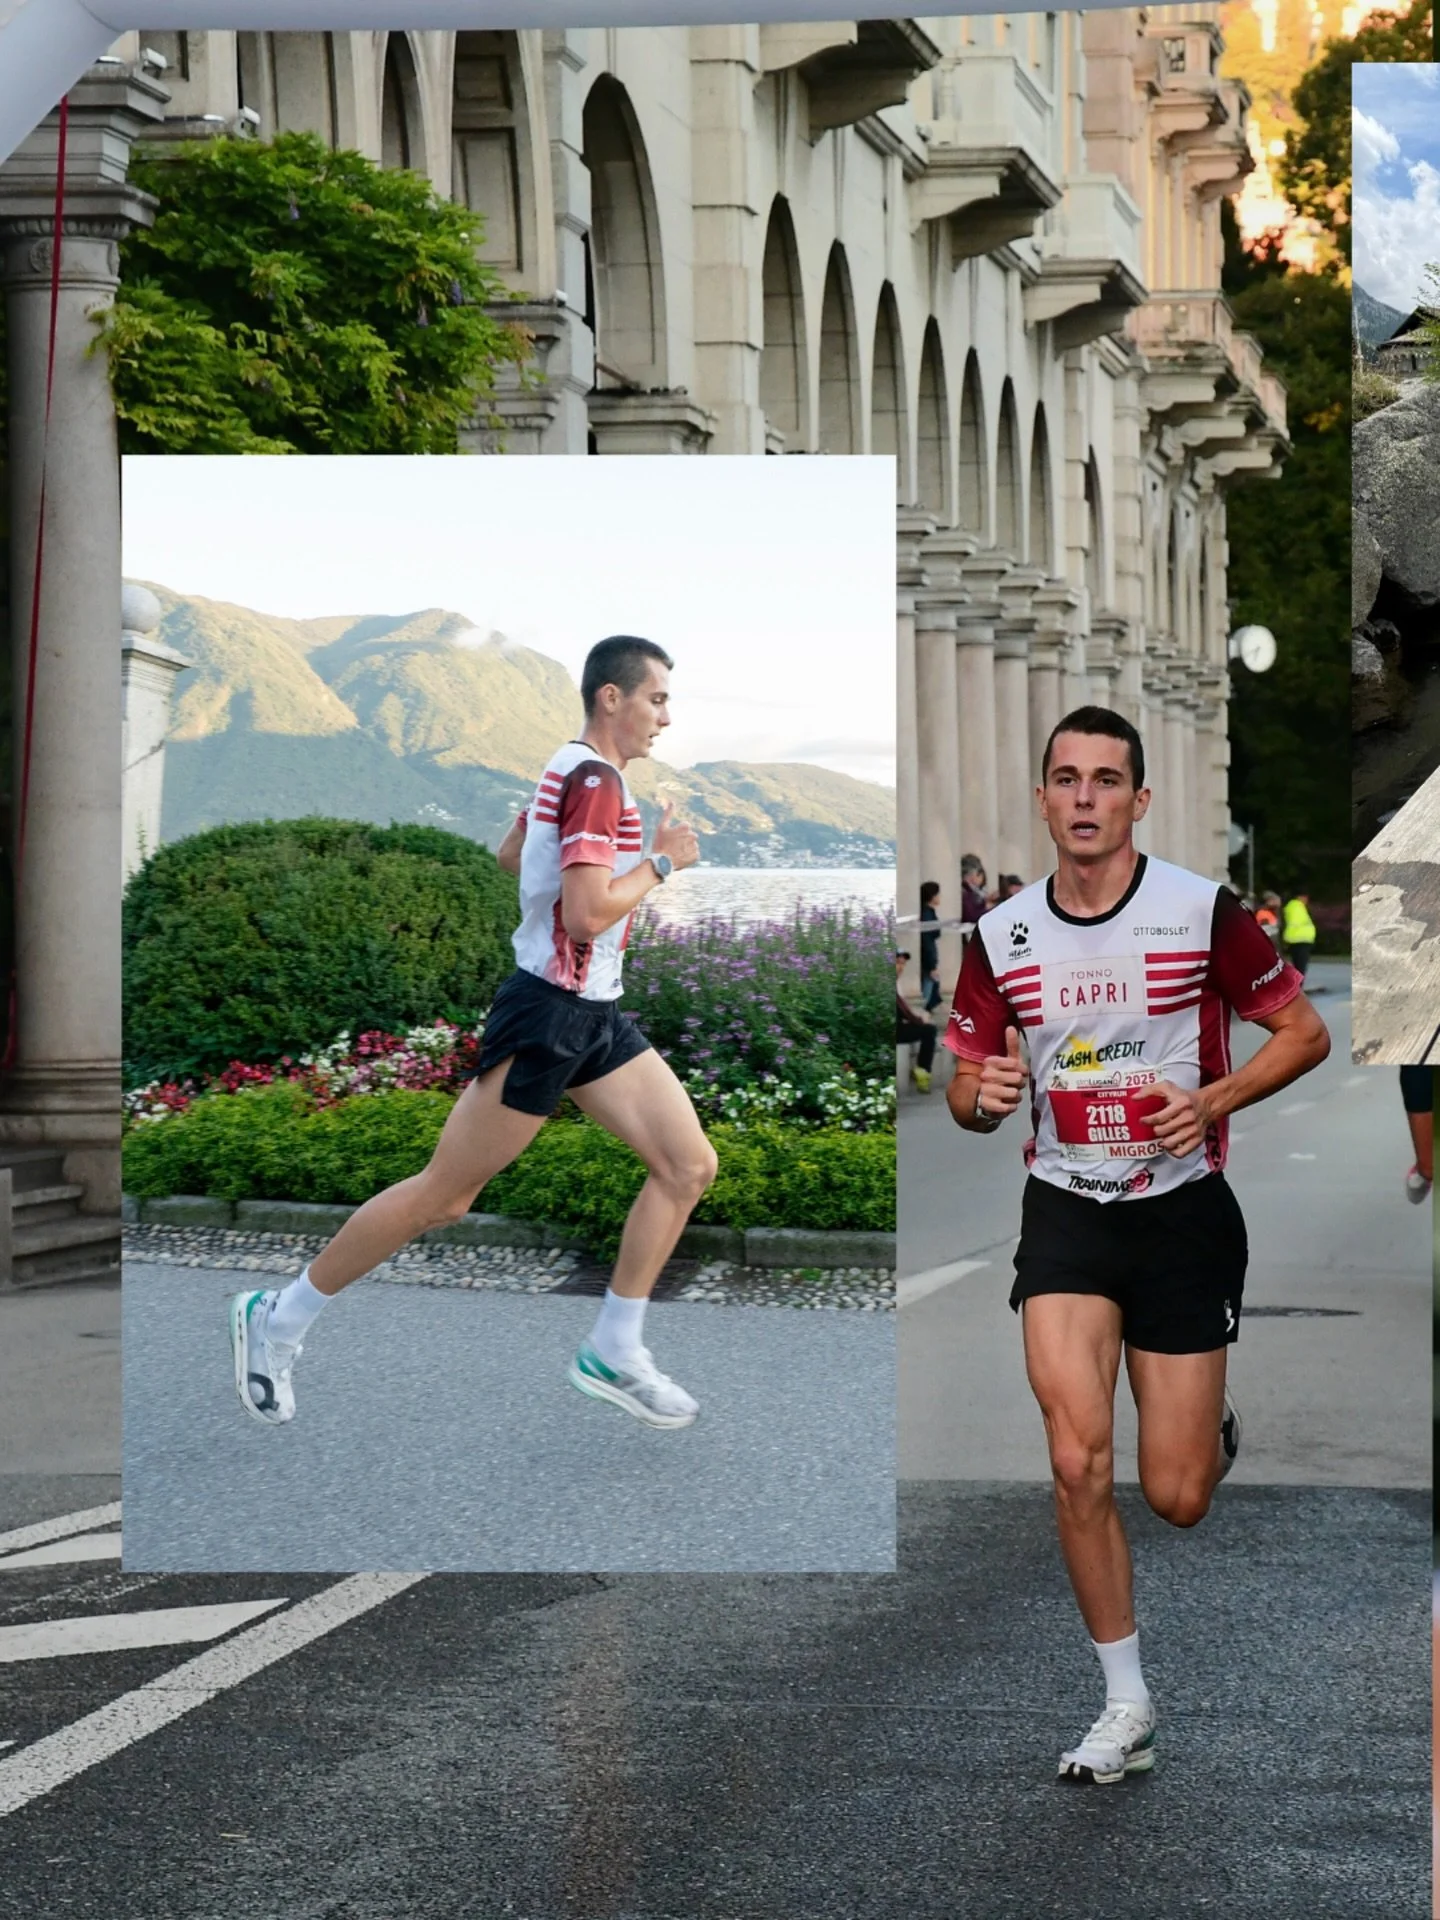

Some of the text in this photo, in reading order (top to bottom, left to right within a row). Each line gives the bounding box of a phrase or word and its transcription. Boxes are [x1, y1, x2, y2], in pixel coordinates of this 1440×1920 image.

[1070, 968, 1113, 980] TONNO
[1060, 982, 1127, 1008] CAPRI
[1053, 1040, 1146, 1070] FLASH CREDIT
[1125, 1072, 1156, 1087] 2025
[1086, 1104, 1126, 1125] 2118
[1088, 1126, 1131, 1142] GILLES
[1109, 1140, 1165, 1157] MIGROS
